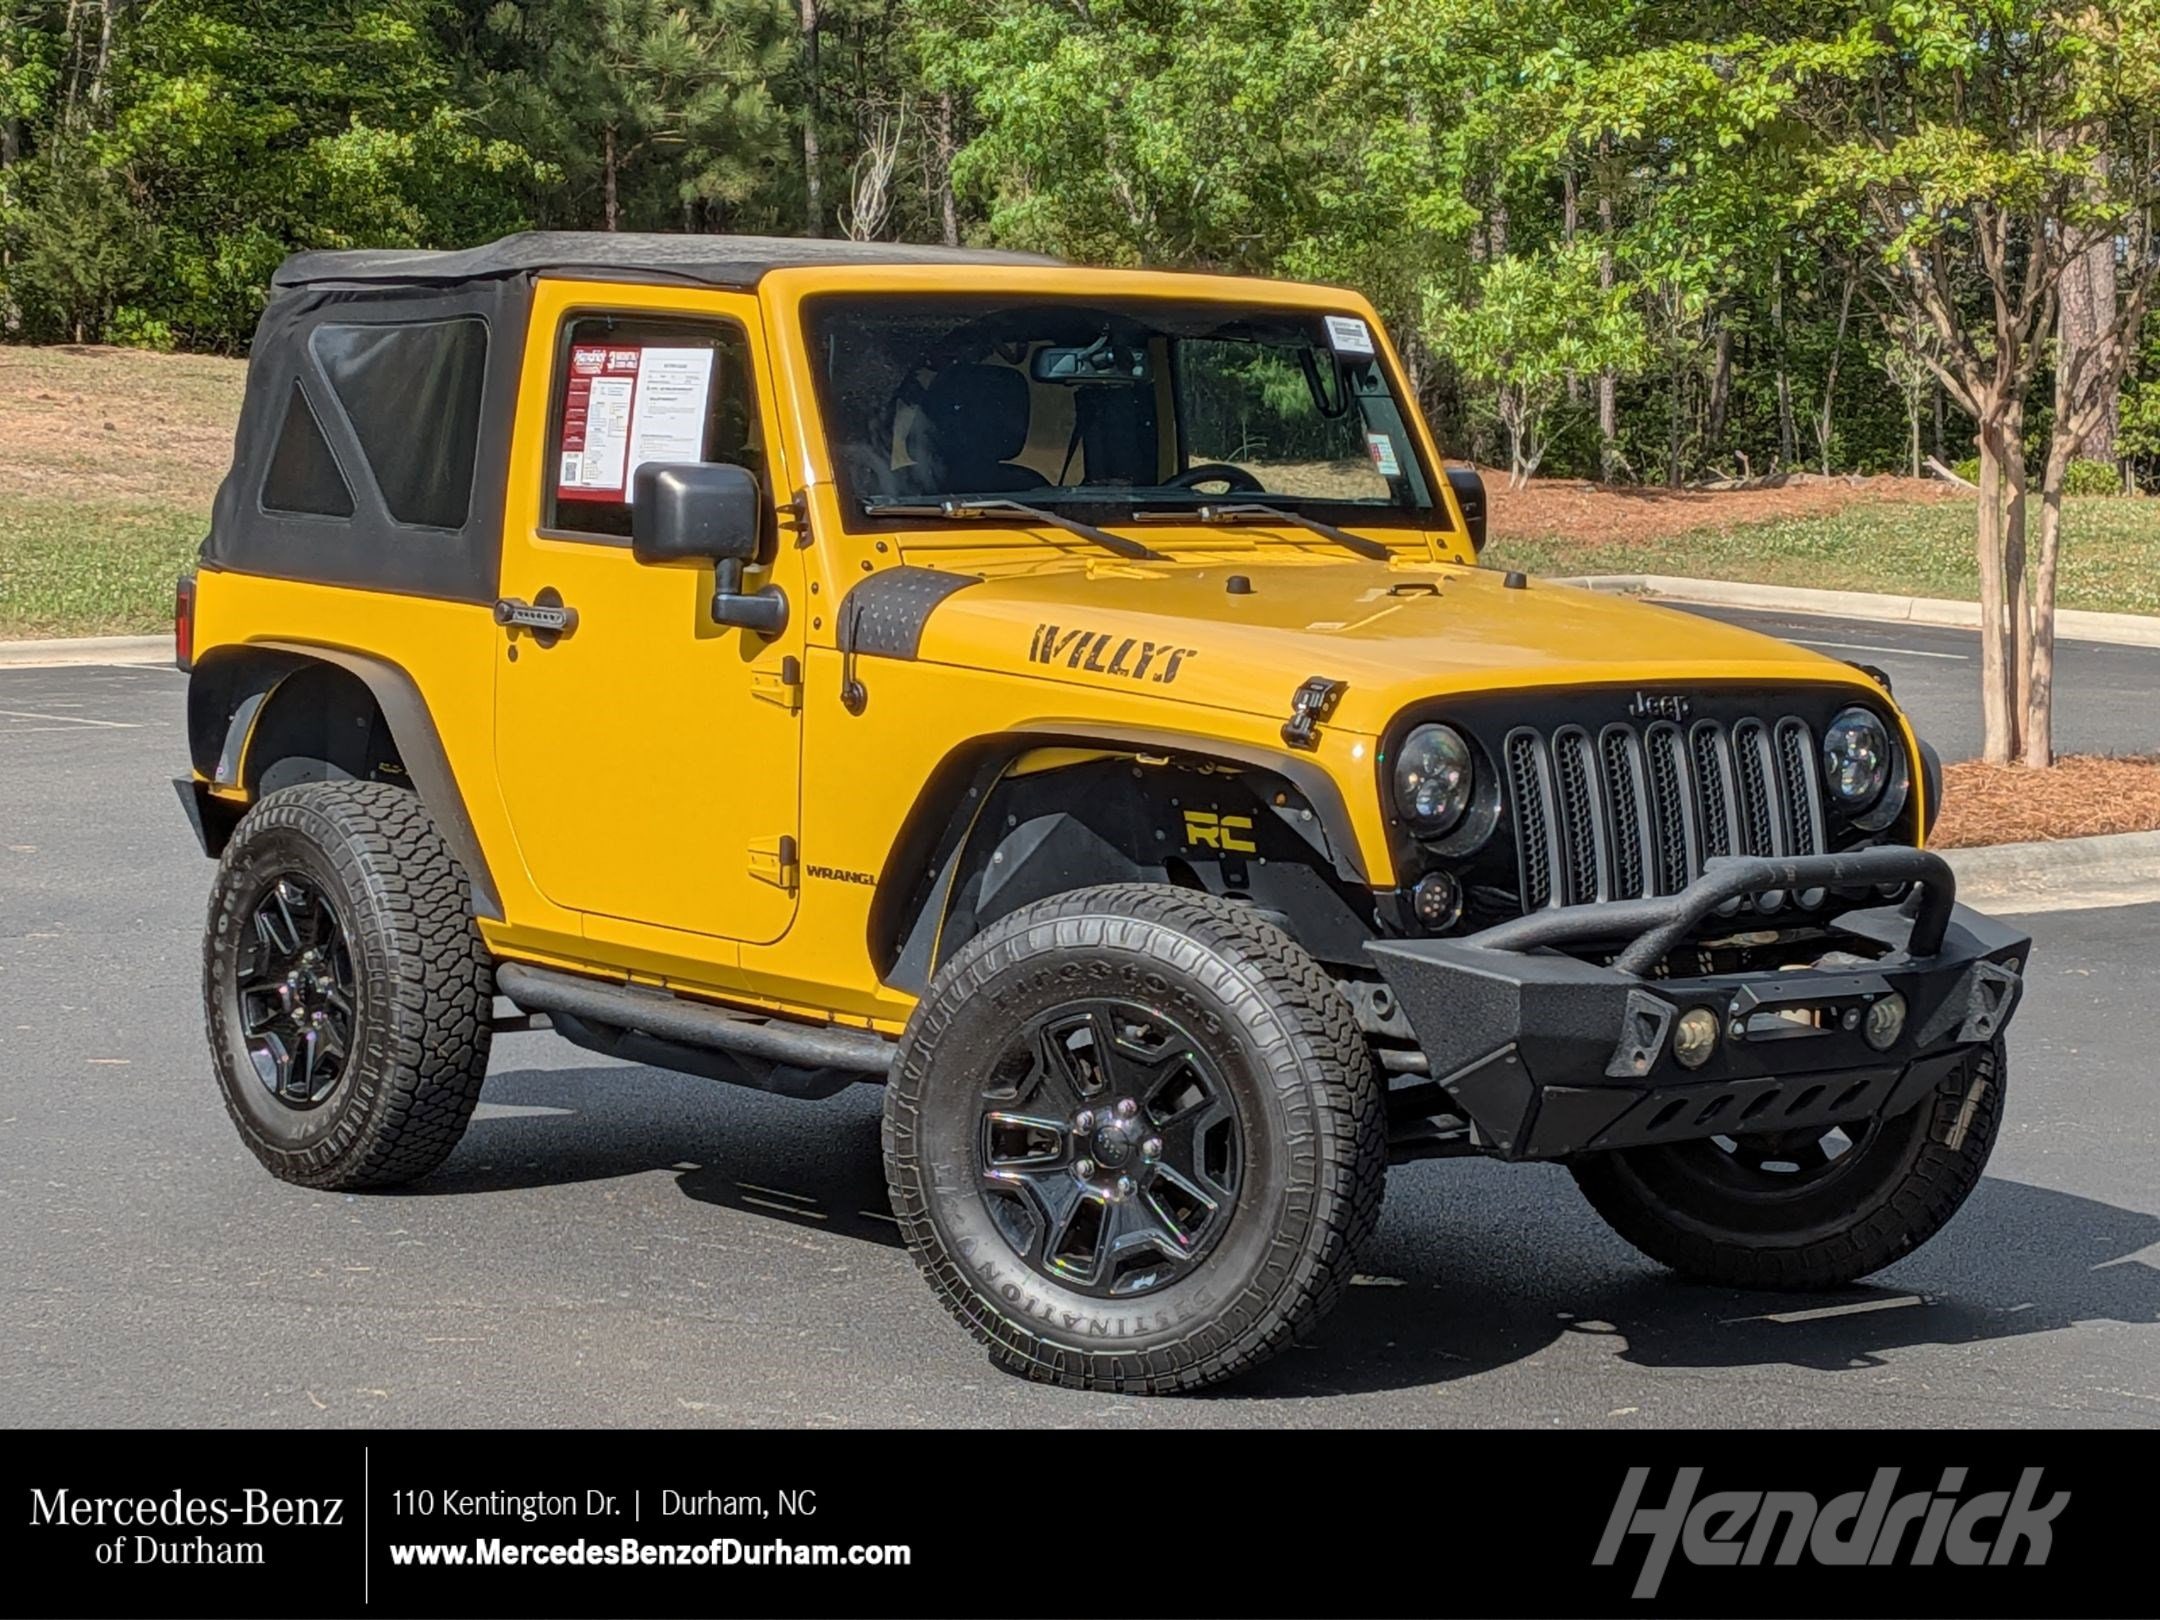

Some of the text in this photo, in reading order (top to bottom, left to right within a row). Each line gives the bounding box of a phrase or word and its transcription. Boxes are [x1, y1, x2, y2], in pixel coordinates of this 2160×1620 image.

[1029, 623, 1198, 684] WILLYS
[1628, 690, 1690, 721] Jeep
[1183, 810, 1256, 853] RC
[806, 864, 877, 887] WRANGL
